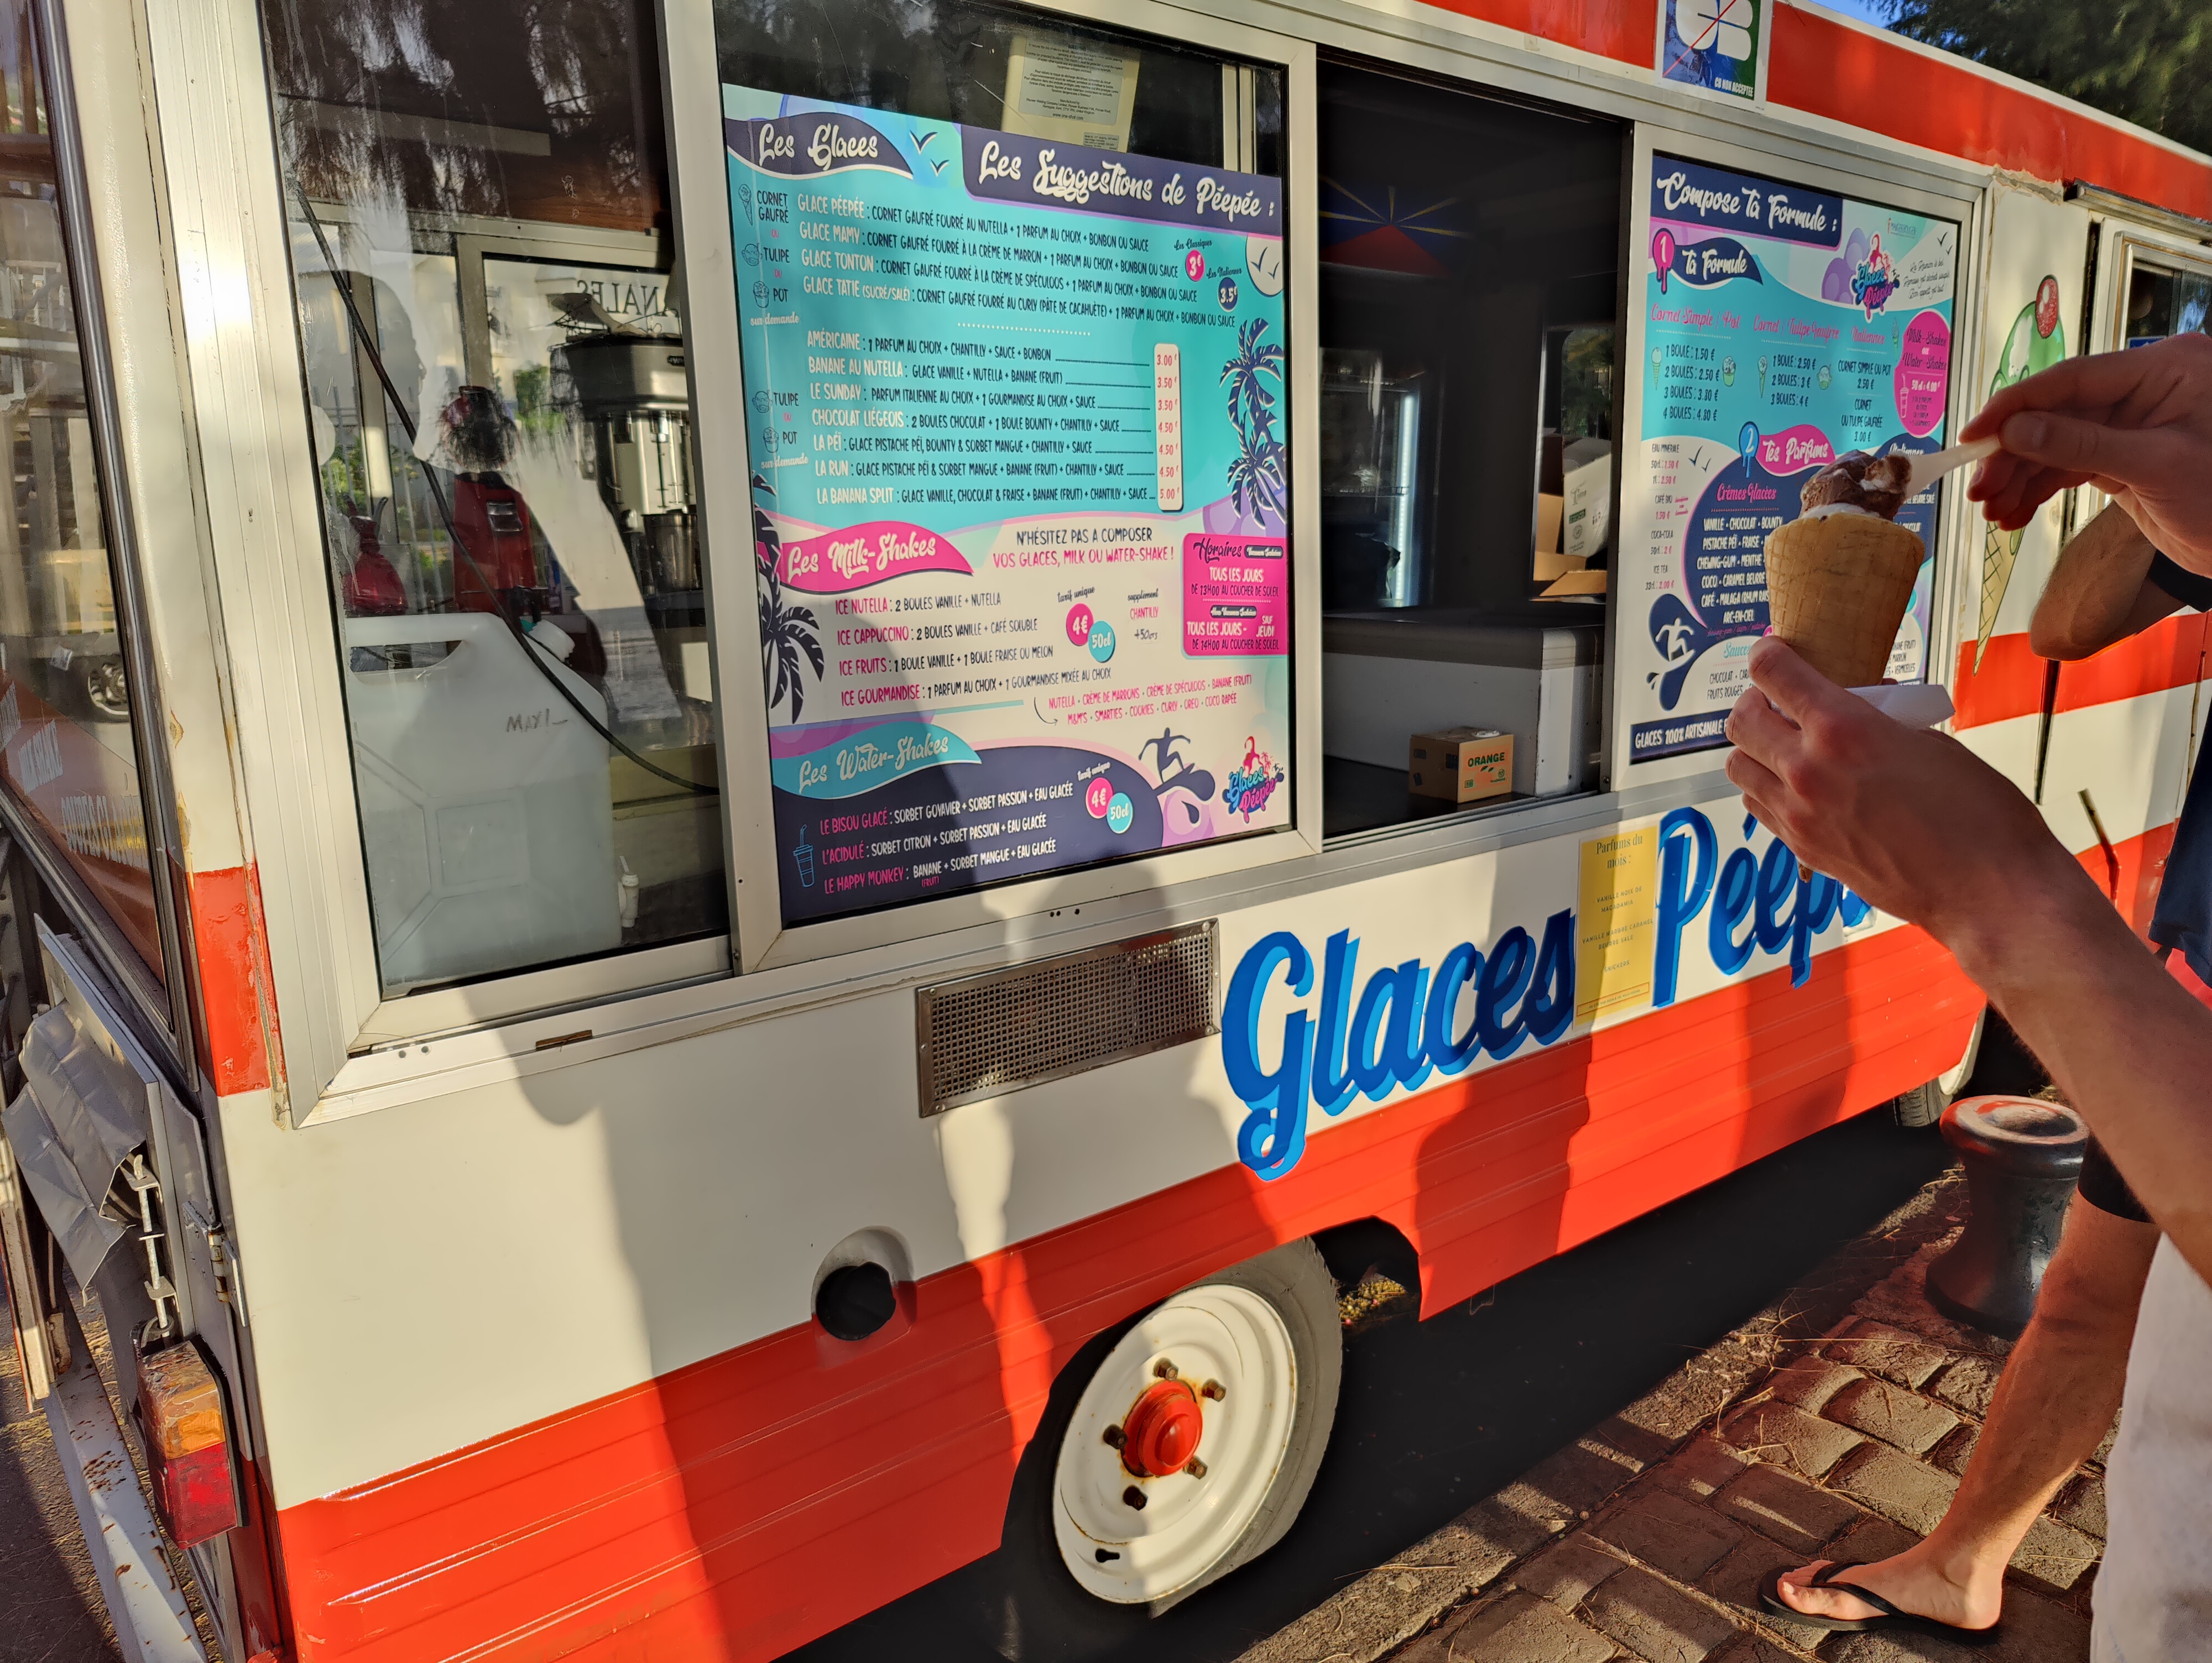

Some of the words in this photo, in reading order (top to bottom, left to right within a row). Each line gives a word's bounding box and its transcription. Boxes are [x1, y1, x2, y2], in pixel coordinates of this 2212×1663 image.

[1715, 77, 1721, 88] CB
[1723, 79, 1731, 91] NON
[1732, 81, 1754, 97] ACCEPTEE
[759, 123, 795, 168] Les
[807, 122, 879, 171] Glaces
[978, 141, 1022, 185] Les
[1032, 149, 1154, 204] Suggestions
[1162, 173, 1186, 206] de
[1196, 177, 1262, 222] Péepée
[757, 190, 789, 207] CORNET
[1656, 171, 1741, 217] Compose
[1741, 186, 1760, 219] Ta
[1767, 194, 1827, 232] Formule
[759, 205, 790, 223] GAUFRÉ
[797, 194, 829, 215] GLACE
[831, 194, 864, 219] PÉEPÉE
[872, 206, 902, 222] CORNET
[905, 210, 934, 227] GAUFRÉ
[936, 213, 964, 231] FOURRÉ
[967, 217, 977, 231] AU
[978, 218, 1009, 237] NUTELLA
[1016, 225, 1021, 237] 1
[1022, 223, 1049, 241] PARFUM
[1051, 227, 1060, 242] AU
[1061, 227, 1082, 245] CHOIX
[1089, 231, 1117, 250] BONBON
[1119, 234, 1128, 250] OU
[1129, 236, 1149, 253] SAUCE
[800, 221, 830, 243] GLACE
[833, 225, 860, 244] MAMY
[763, 247, 790, 264] TULIPE
[1682, 248, 1698, 275] Ta
[1702, 249, 1747, 280] Formule
[773, 288, 789, 302] POT
[803, 275, 833, 296] GLACE
[837, 279, 860, 298] TATIE
[750, 316, 763, 326] sur
[763, 311, 800, 325] demande
[1682, 306, 1713, 332] Simple
[807, 328, 861, 351] AMÉRICAINE
[1666, 345, 1669, 358] 1
[1671, 343, 1690, 358] BOULE
[1695, 347, 1709, 360] 1.50
[808, 355, 846, 375] BANANE
[849, 358, 861, 376] AU
[864, 359, 903, 378] NUTELLA
[1665, 366, 1669, 378] 2
[1671, 364, 1693, 379] BOULES
[1698, 369, 1713, 381] 2.50
[1838, 359, 1856, 373] CORNET
[1858, 362, 1874, 375] SIMPLE
[1882, 364, 1891, 376] POT
[812, 408, 860, 427] CHOCOLAT
[864, 407, 904, 428] LIÉGEOIS
[1746, 427, 1755, 454] 2
[1762, 440, 1780, 462] Tes
[1785, 437, 1829, 466] Parfums
[817, 488, 828, 504] LA
[831, 487, 868, 504] BANANA
[870, 487, 894, 504] SPLIT
[1703, 517, 1724, 531] VANILLE
[1729, 516, 1757, 530] CHOCOLAT
[1761, 516, 1783, 529] BOUNTY
[1071, 529, 1089, 544] PAS
[1092, 529, 1098, 543] A
[1102, 527, 1152, 542] COMPOSER
[1703, 537, 1728, 550] PISTACHE
[1742, 535, 1760, 548] FRAISE
[787, 546, 819, 584] Les
[828, 531, 936, 580] Milk-Shakes
[993, 553, 1016, 568] VOS
[1019, 551, 1061, 568] GLACES,
[1063, 550, 1086, 565] MILK
[1089, 548, 1103, 563] OU
[1106, 546, 1167, 563] WATER-SHAKE
[1193, 537, 1242, 564] Horaires
[1697, 555, 1736, 570] CHEWING-GUM
[1741, 553, 1762, 567] MENTHE
[1209, 567, 1227, 582] TOUS
[1228, 567, 1240, 582] LES
[1242, 567, 1264, 583] JOURS
[1702, 574, 1718, 589] COCO
[1723, 572, 1746, 587] CARAMEL
[1746, 572, 1766, 585] BEURRE
[835, 599, 849, 615] ICE
[851, 597, 889, 614] NUTELLA
[895, 598, 901, 612] 2
[904, 596, 933, 610] BOULES
[935, 594, 962, 609] VANILLE
[971, 593, 1001, 606] NUTELLA
[1130, 606, 1159, 620] CHANTILLY
[1261, 615, 1273, 625] SAUF
[1723, 609, 1755, 624] ARC-EN-CIEL
[837, 630, 851, 646] ICE
[854, 625, 909, 644] CAPPUCCINO
[1256, 625, 1275, 637] JEUDI
[1709, 671, 1733, 684] CHOCOLAT
[841, 691, 854, 707] ICE
[858, 684, 921, 704] GOURMANDISE
[1707, 687, 1723, 700] FRUITS
[1724, 684, 1743, 698] ROUGES
[1635, 729, 1662, 749] GLACES
[1684, 720, 1723, 740] ARTISANALE
[798, 760, 828, 794] Les
[836, 733, 950, 781] Water-Shakes
[1467, 752, 1505, 767] ORANGE
[820, 819, 831, 836] LE
[832, 815, 860, 834] BISOU
[862, 807, 889, 829] GLACÉ
[894, 806, 923, 824] SORBET
[926, 800, 961, 819] GOYAVIER
[968, 794, 996, 812] SORBET
[998, 789, 1027, 808] PASSION
[1034, 786, 1048, 802] EAU
[1049, 781, 1073, 799] GLACÉE
[1596, 837, 1631, 855] Parfums
[1632, 834, 1643, 845] du
[1607, 853, 1627, 869] mois
[824, 878, 835, 895] LE
[837, 872, 865, 892] HAPPY
[868, 866, 905, 886] MONKEY
[1597, 892, 1619, 903] VANILLE
[1620, 888, 1634, 898] NOIX
[1601, 900, 1634, 913] MACADAMIA
[1582, 933, 1604, 944] VANILLE
[1606, 926, 1627, 938] MARBRE
[1629, 918, 1653, 930] CARAMEL
[1598, 940, 1619, 950] BEURRE
[1620, 935, 1634, 945] SALE
[1604, 960, 1630, 973] SNICKERS
[1221, 907, 1576, 1182] Glaces
